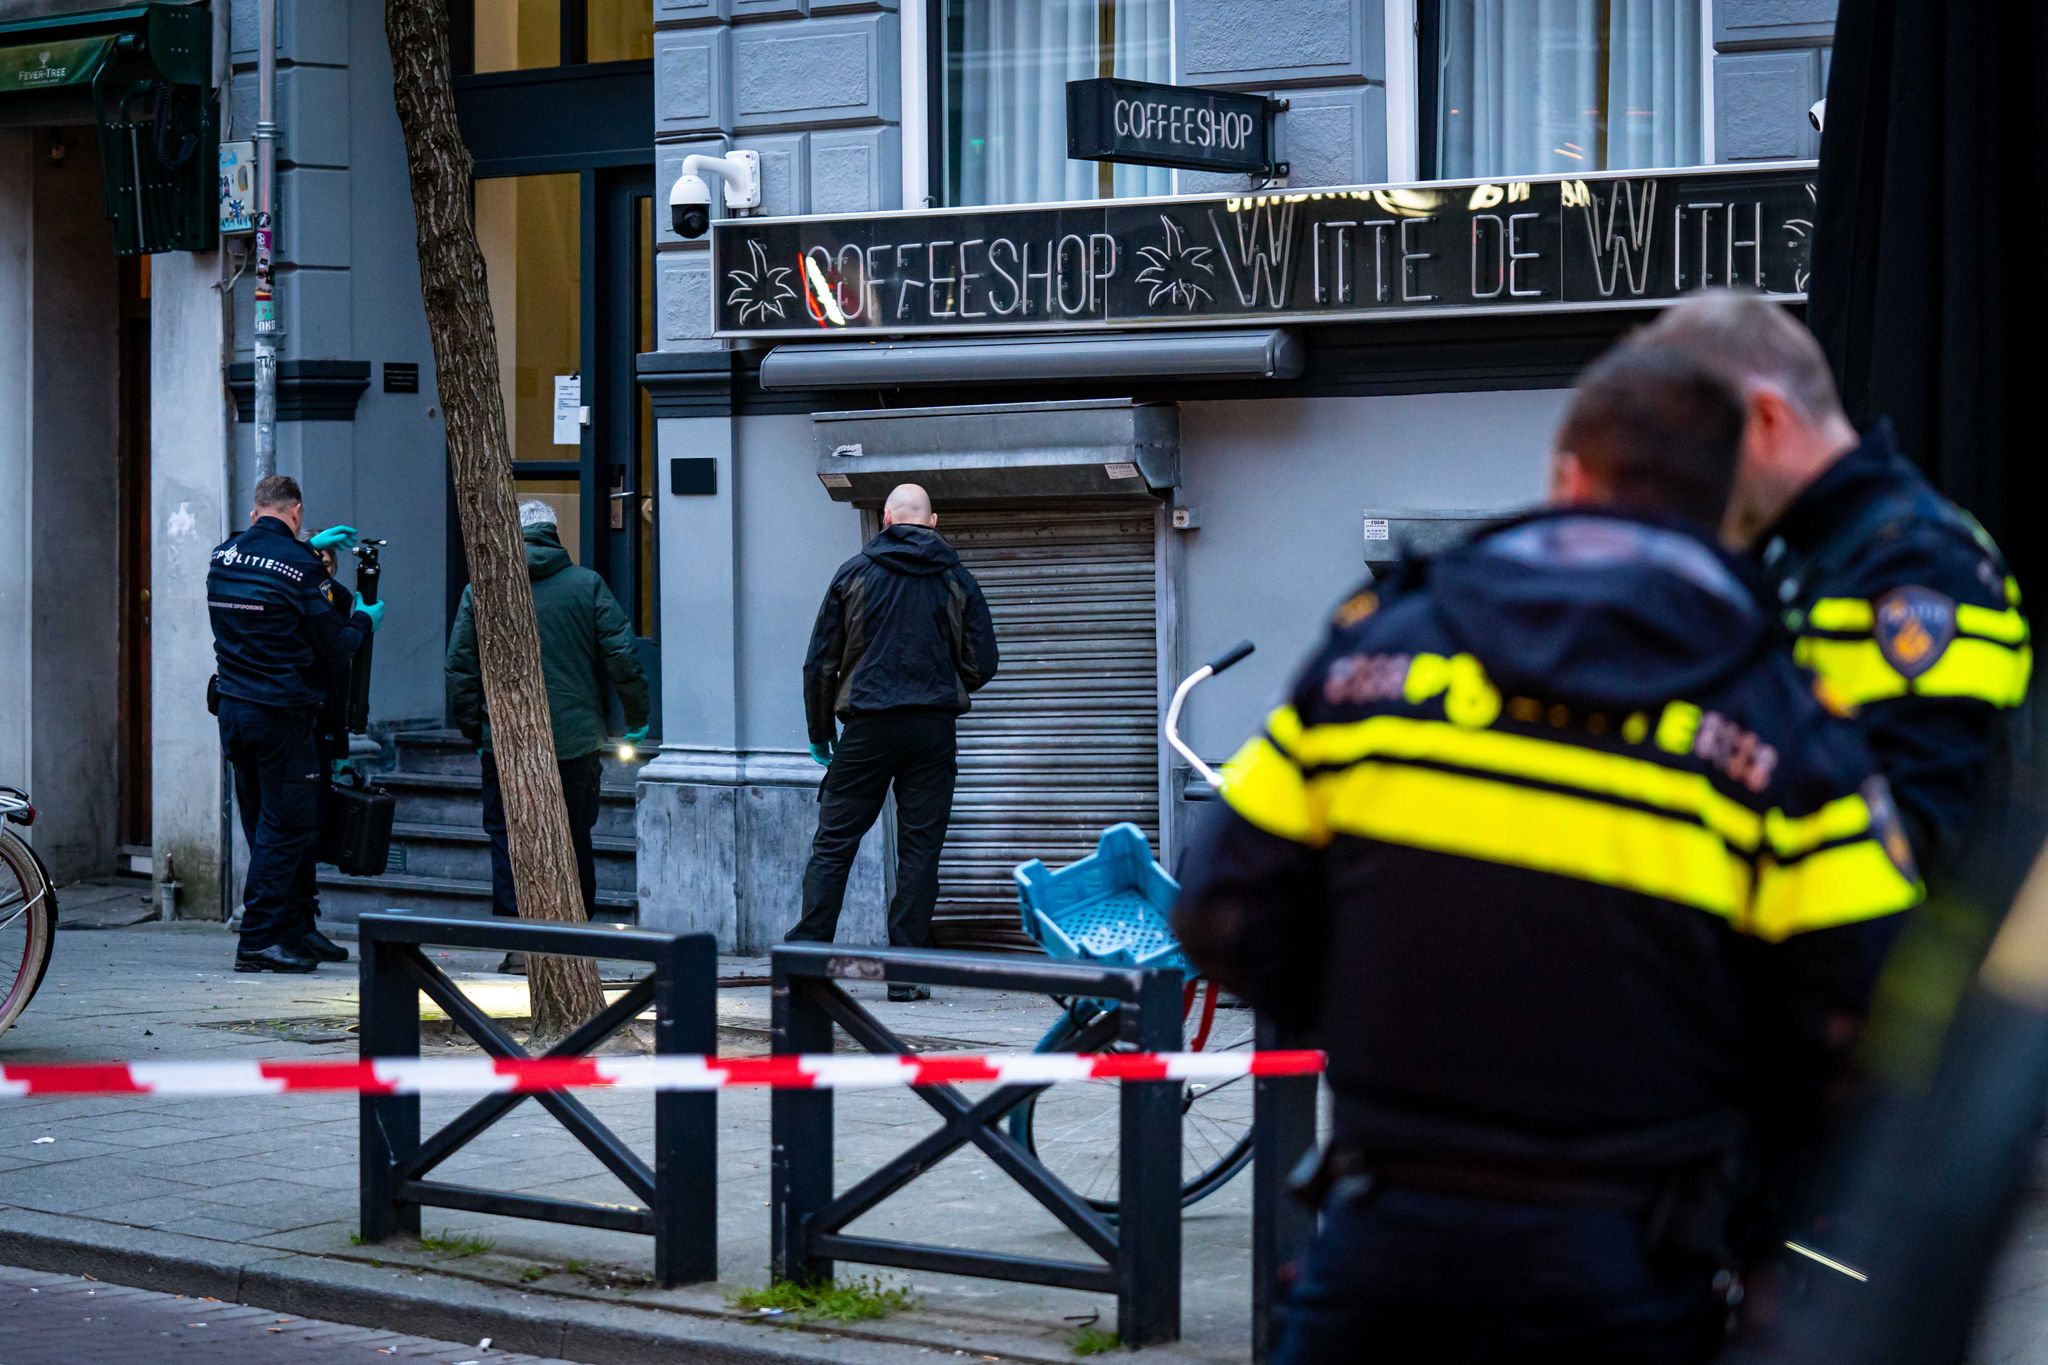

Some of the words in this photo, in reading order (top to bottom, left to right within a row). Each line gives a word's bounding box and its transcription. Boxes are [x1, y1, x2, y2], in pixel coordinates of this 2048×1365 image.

[18, 67, 67, 81] FEVER-TREE
[1114, 99, 1253, 151] COFFEESHOP
[805, 233, 1117, 321] COFFEESHOP
[1207, 196, 1438, 309] WITTE
[1471, 212, 1546, 300] DE
[1582, 180, 1762, 297] WITH
[216, 545, 275, 569] POLITIE
